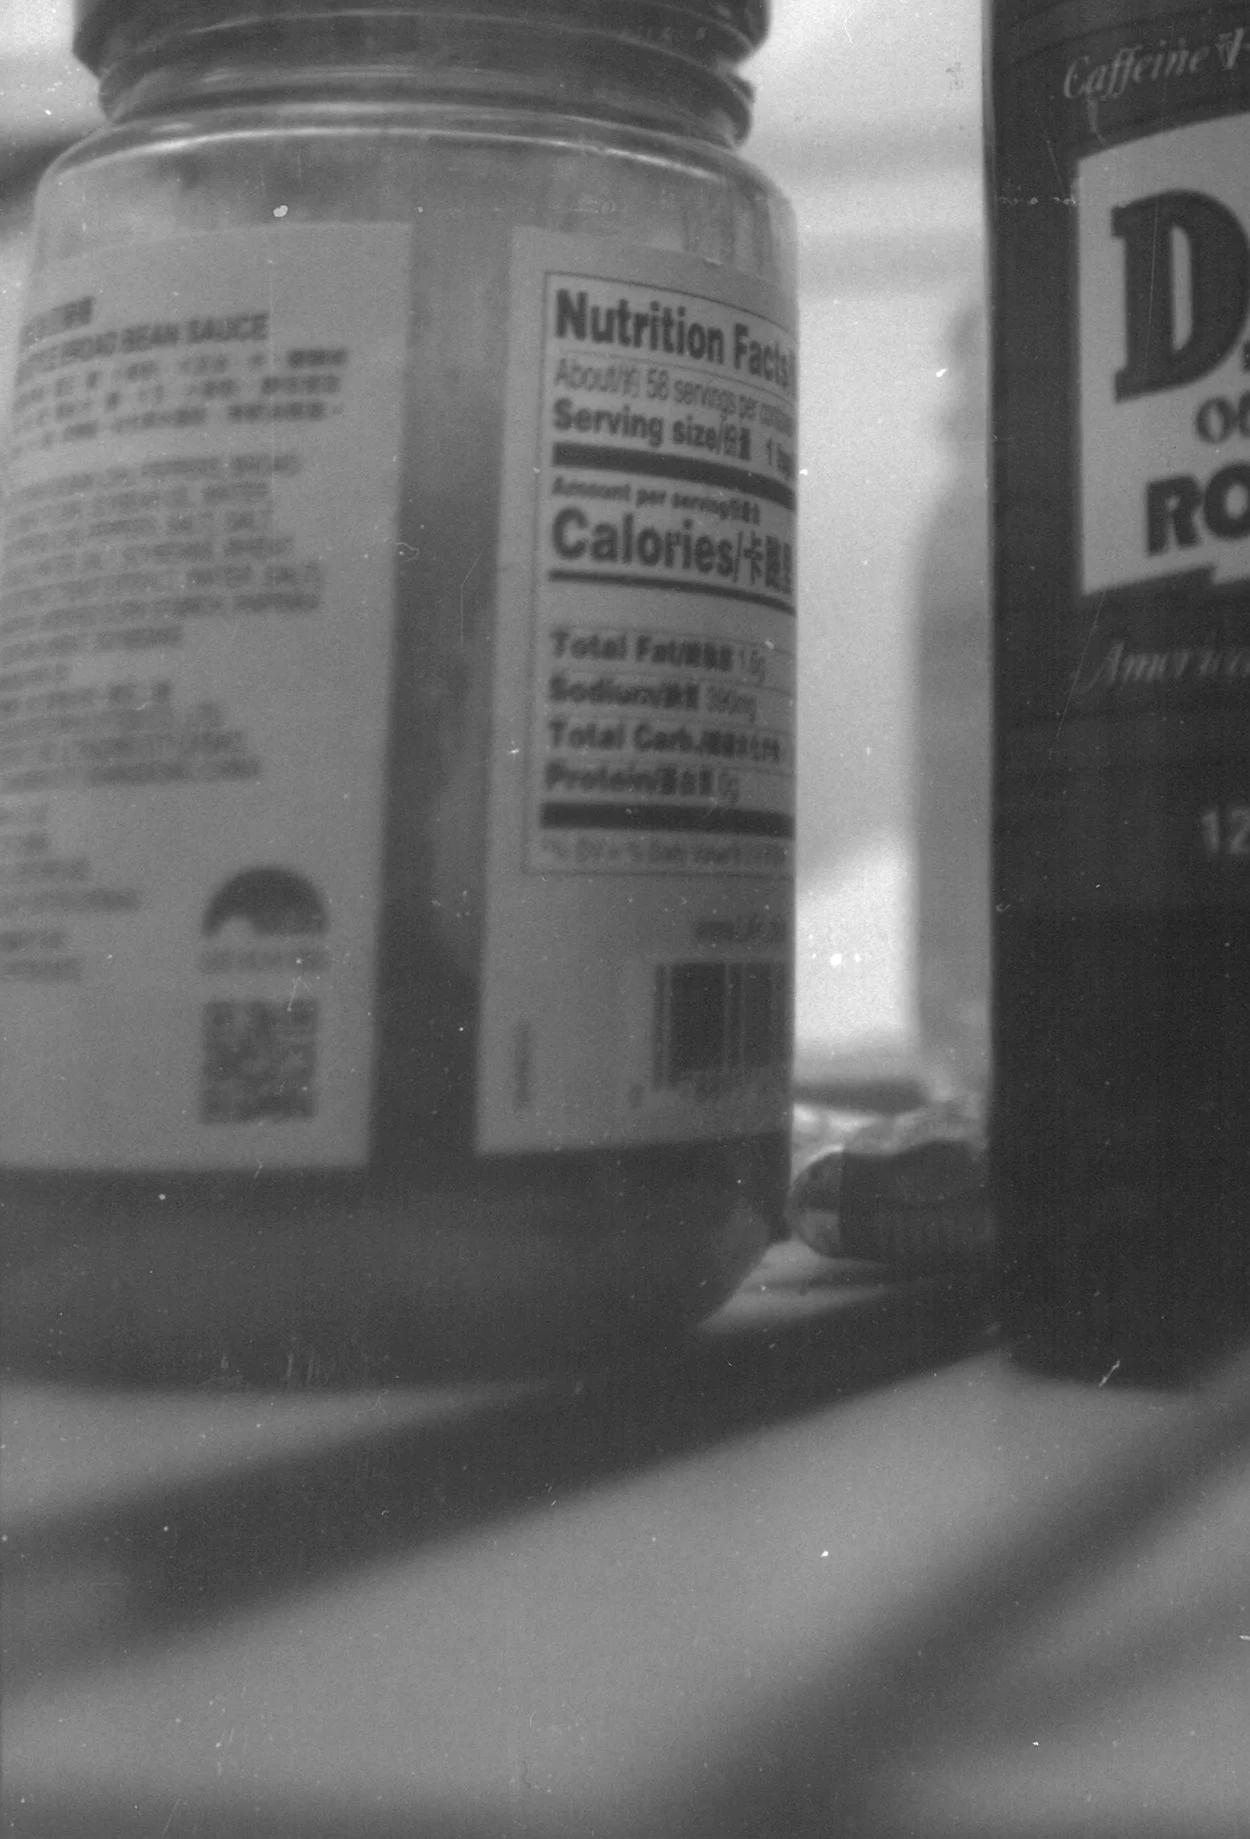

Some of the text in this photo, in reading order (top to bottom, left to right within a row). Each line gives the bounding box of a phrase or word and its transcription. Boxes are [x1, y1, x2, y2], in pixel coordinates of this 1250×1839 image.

[1062, 37, 1211, 100] Caffeine
[556, 290, 724, 365] Nutrition
[553, 398, 665, 448] Serving
